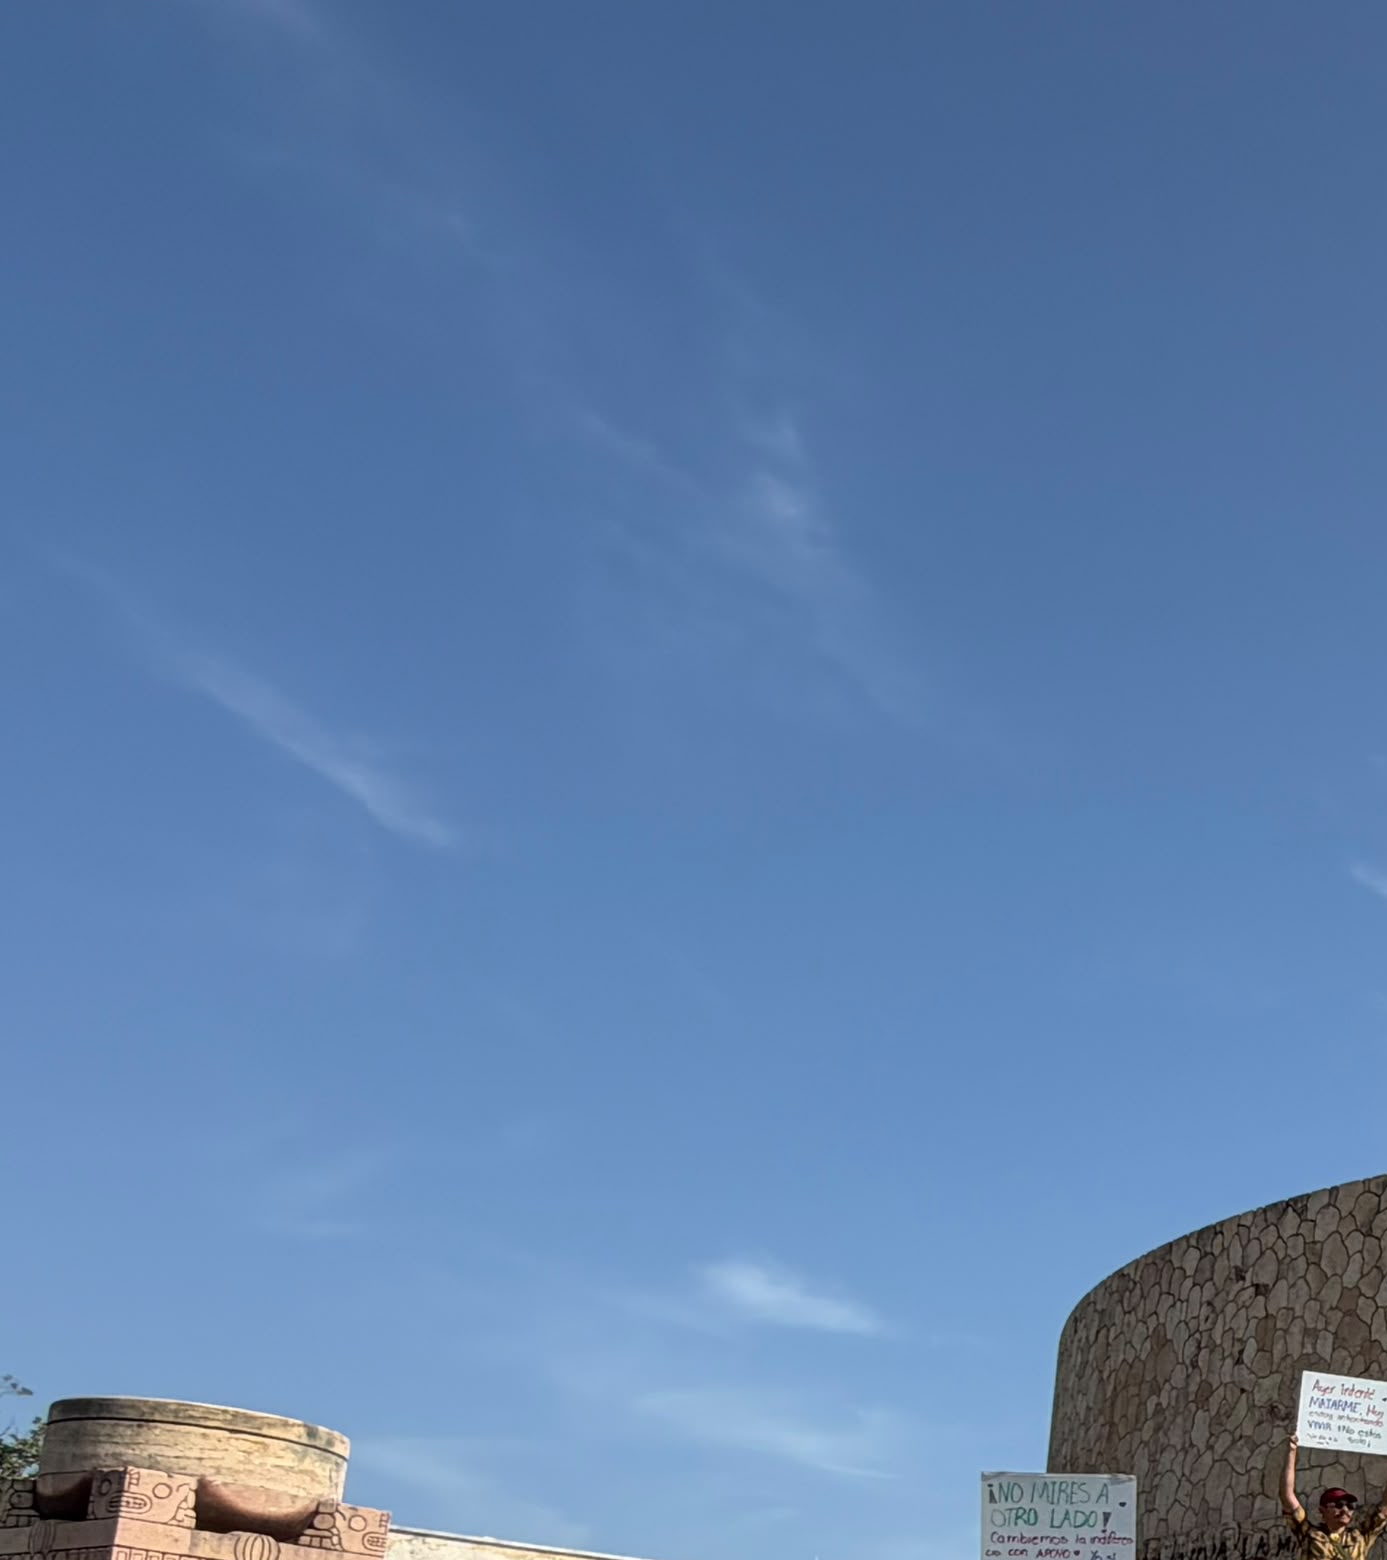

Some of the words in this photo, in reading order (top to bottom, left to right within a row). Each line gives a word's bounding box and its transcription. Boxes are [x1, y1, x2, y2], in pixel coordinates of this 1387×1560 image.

[1312, 1379, 1335, 1396] Ayer
[987, 1482, 1024, 1504] ¡NO
[1031, 1481, 1091, 1505] MIRES
[1095, 1483, 1110, 1504] A
[991, 1507, 1038, 1528] OTRO
[990, 1531, 1069, 1546] Cambiemos
[1075, 1533, 1087, 1545] la
[1008, 1548, 1028, 1557] con
[1036, 1549, 1071, 1559] APOYO
